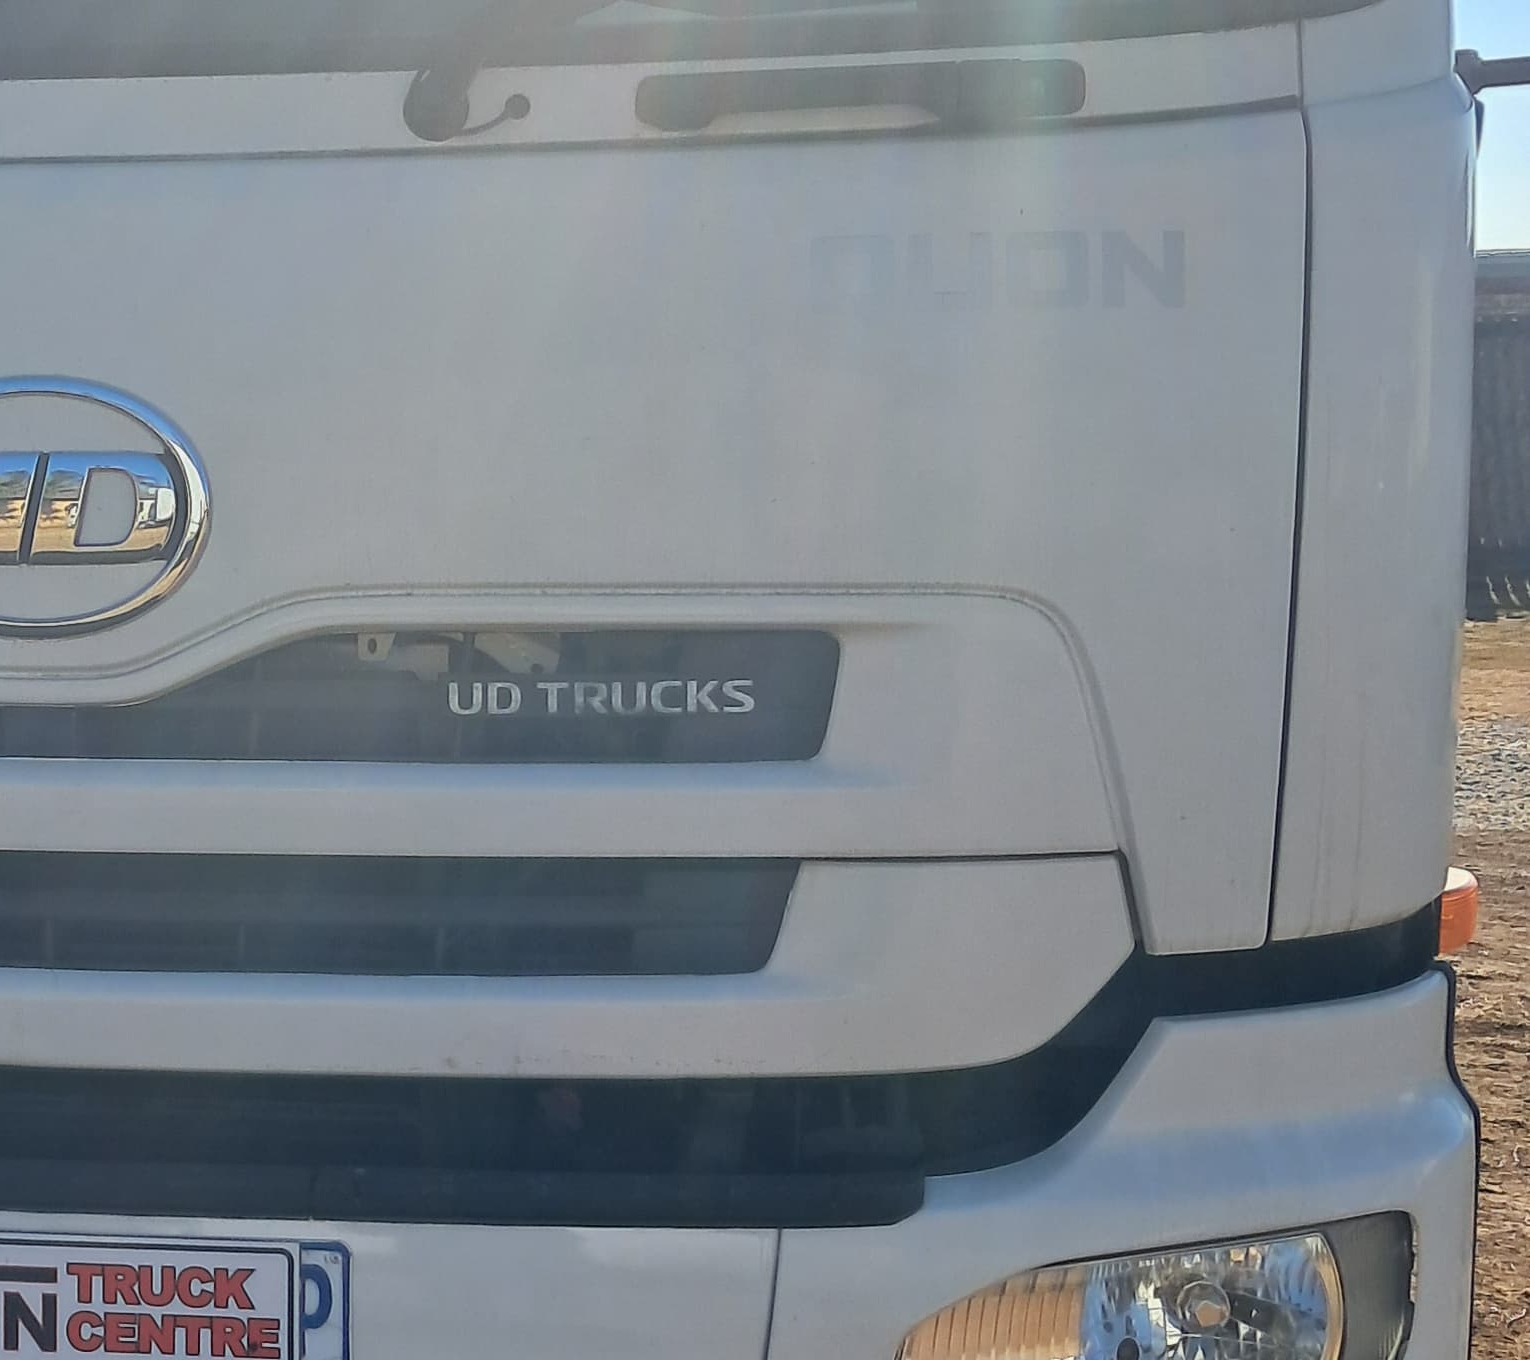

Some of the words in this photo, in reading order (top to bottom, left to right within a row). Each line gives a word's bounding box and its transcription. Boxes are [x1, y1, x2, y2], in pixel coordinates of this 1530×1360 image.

[447, 680, 522, 715] UD
[536, 679, 756, 715] TRUCKS
[66, 1261, 256, 1311] TRUCK
[65, 1311, 282, 1360] CENTRE
